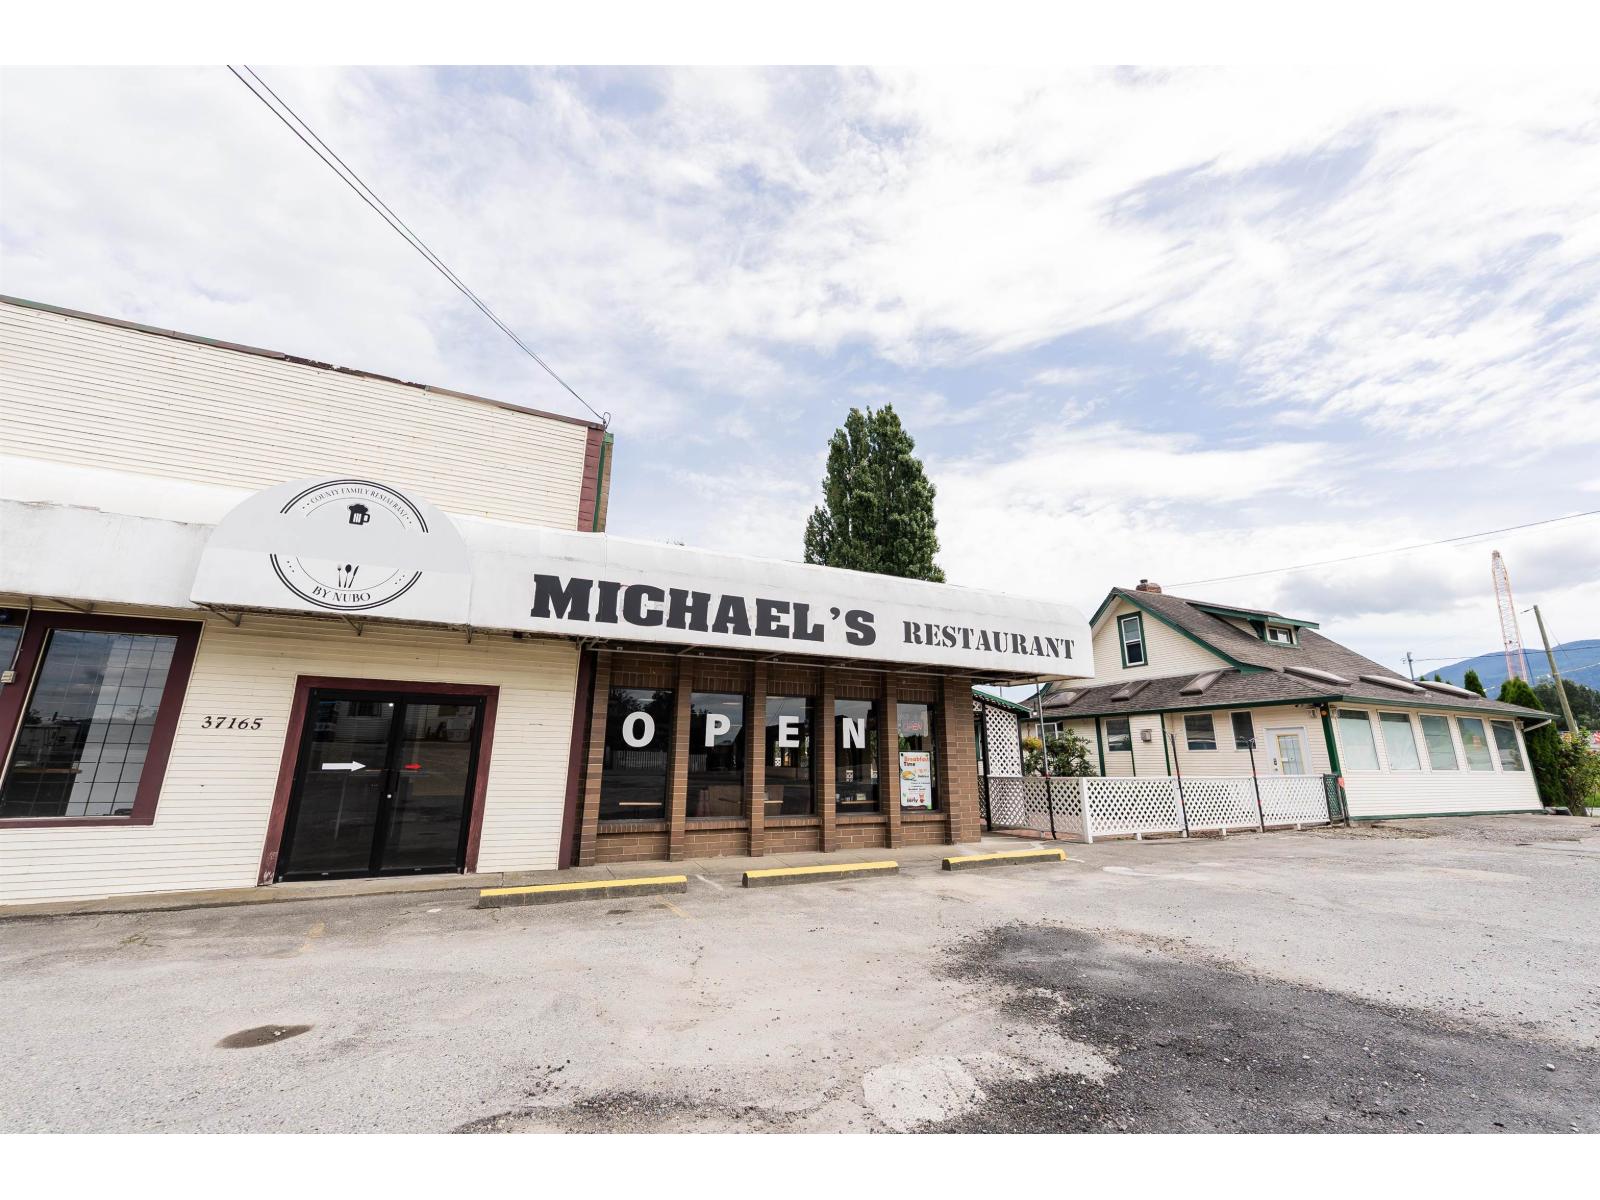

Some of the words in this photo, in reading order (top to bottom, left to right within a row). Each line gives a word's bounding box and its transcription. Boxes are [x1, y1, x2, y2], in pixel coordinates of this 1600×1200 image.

[310, 488, 341, 505] COUNTY
[341, 487, 370, 495] FAMILY
[370, 490, 408, 517] RESTAURANT
[311, 585, 332, 598] BY
[332, 592, 371, 602] NUBO
[530, 574, 878, 647] MICHAEL'S
[902, 620, 1076, 661] RESTAURANT
[201, 715, 264, 731] 37165
